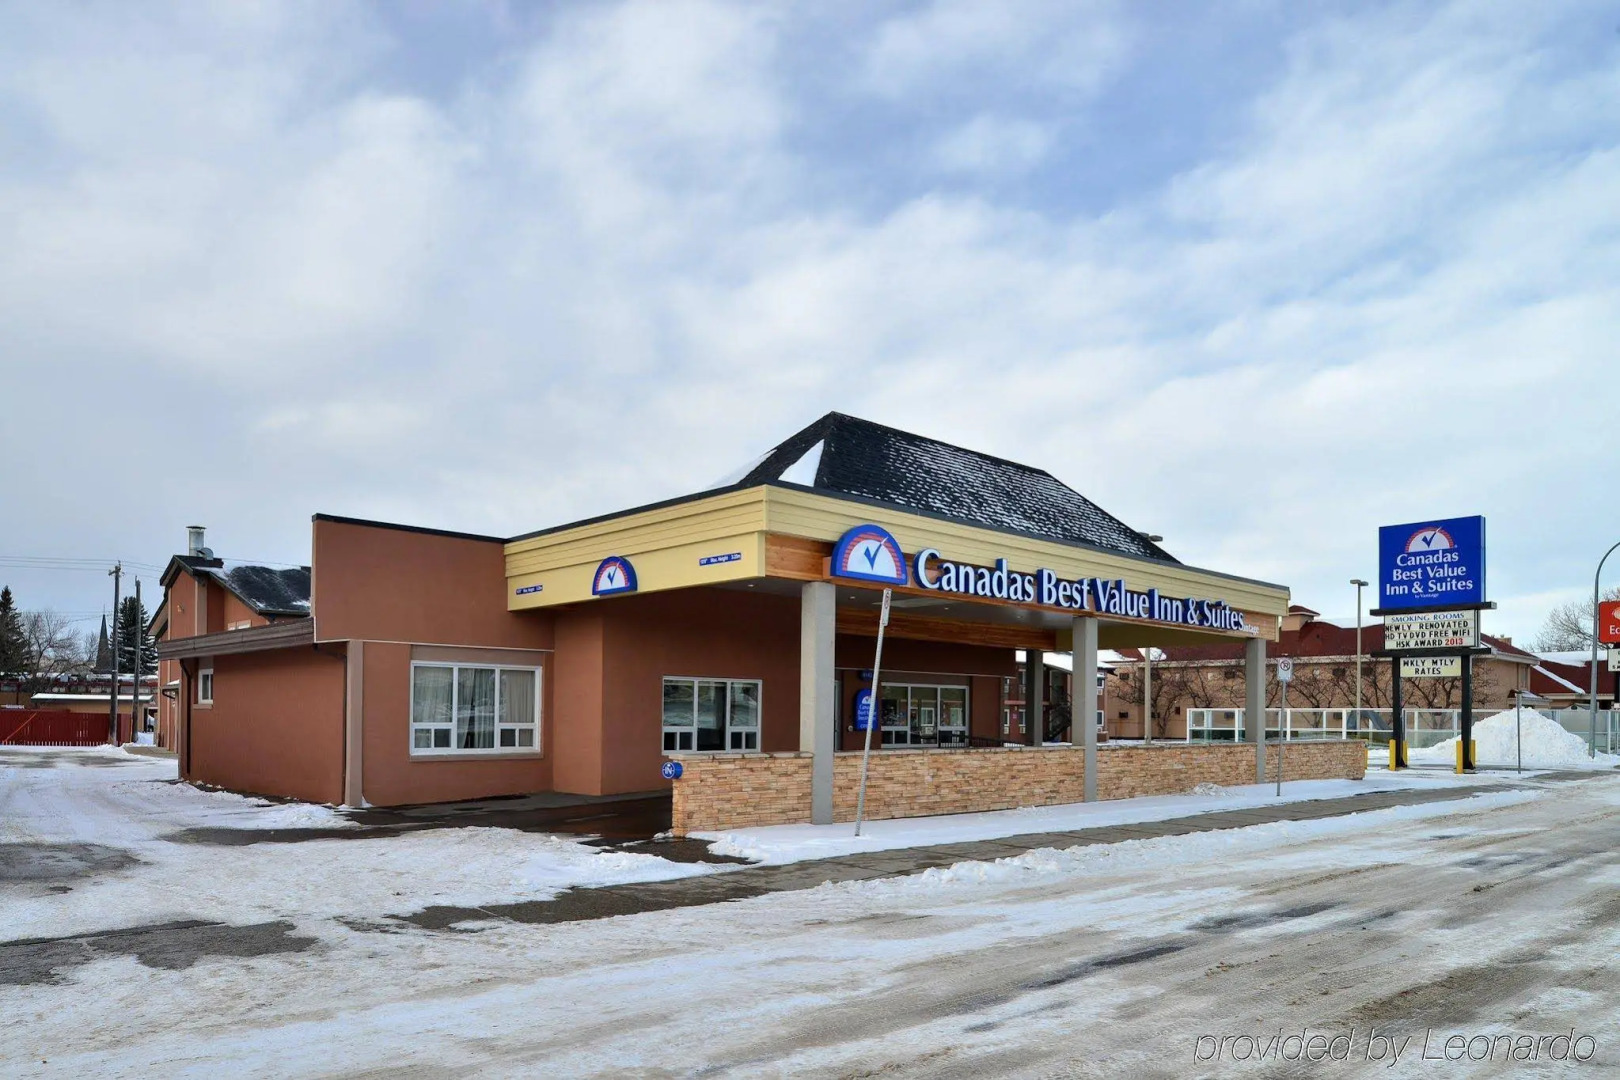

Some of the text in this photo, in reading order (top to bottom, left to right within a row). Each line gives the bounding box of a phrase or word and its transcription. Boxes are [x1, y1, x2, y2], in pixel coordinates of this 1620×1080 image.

[1396, 549, 1459, 567] Canadas
[1392, 564, 1467, 581] Best Value
[913, 547, 1244, 631] Canadas Best Value Inn & Suites
[1386, 577, 1474, 596] Inn & Suites
[1391, 614, 1430, 622] SMOKING
[1385, 620, 1469, 632] NEWLY RENOVATED
[1429, 629, 1449, 638] FREE
[1452, 628, 1470, 637] WIFI
[1396, 637, 1464, 648] HSK AWARD 2013
[1431, 658, 1455, 666] MTLY
[1414, 667, 1441, 675] RATES
